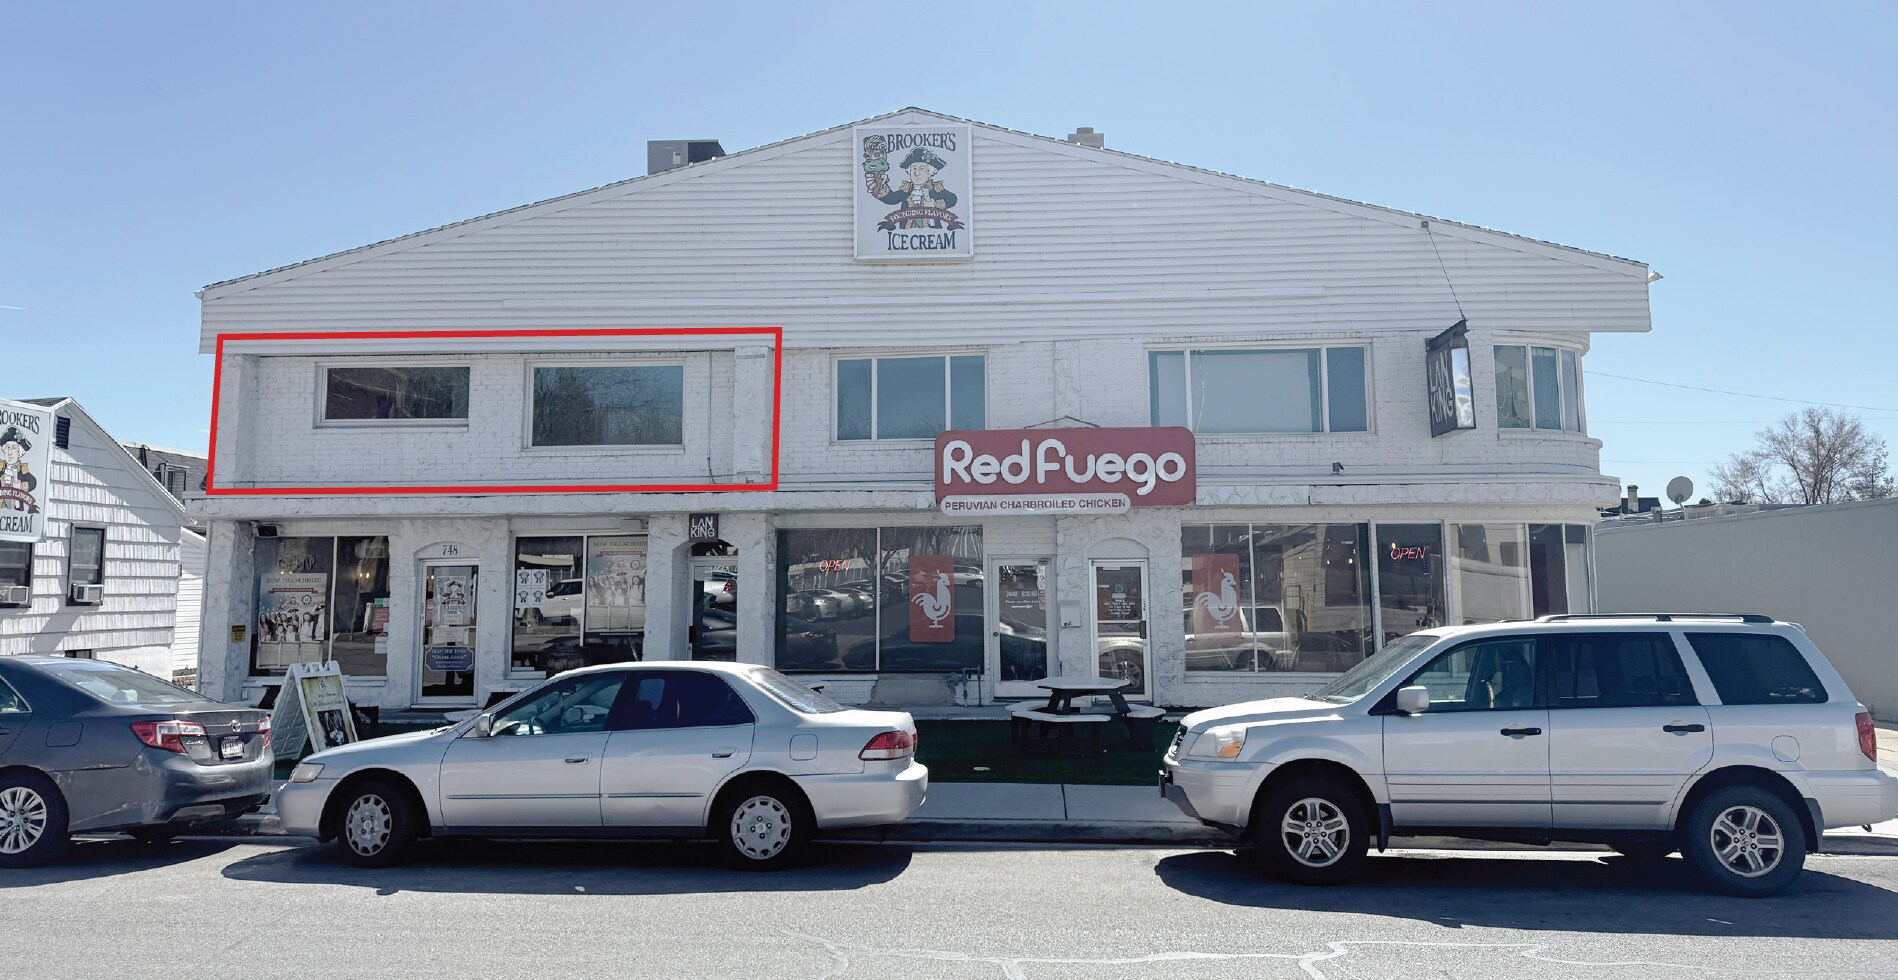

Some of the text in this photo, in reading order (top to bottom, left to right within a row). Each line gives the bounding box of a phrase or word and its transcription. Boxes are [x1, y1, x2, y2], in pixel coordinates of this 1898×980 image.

[886, 132, 956, 154] BROOKER'S
[890, 209, 953, 222] FOUNDING FLAVORS
[887, 231, 956, 251] ICE CREAM
[1428, 349, 1450, 393] LAN
[1430, 386, 1454, 425] KING
[0, 410, 40, 435] OOKER'S
[943, 438, 1031, 485] Red
[945, 498, 1126, 511] PERUVIAN CHARBROILED CHICKEN
[0, 514, 33, 533] CREAM
[691, 516, 714, 529] LAN
[690, 526, 715, 540] KING
[442, 545, 458, 555] 748
[1390, 547, 1426, 560] OPEN
[819, 559, 851, 572] OPEN
